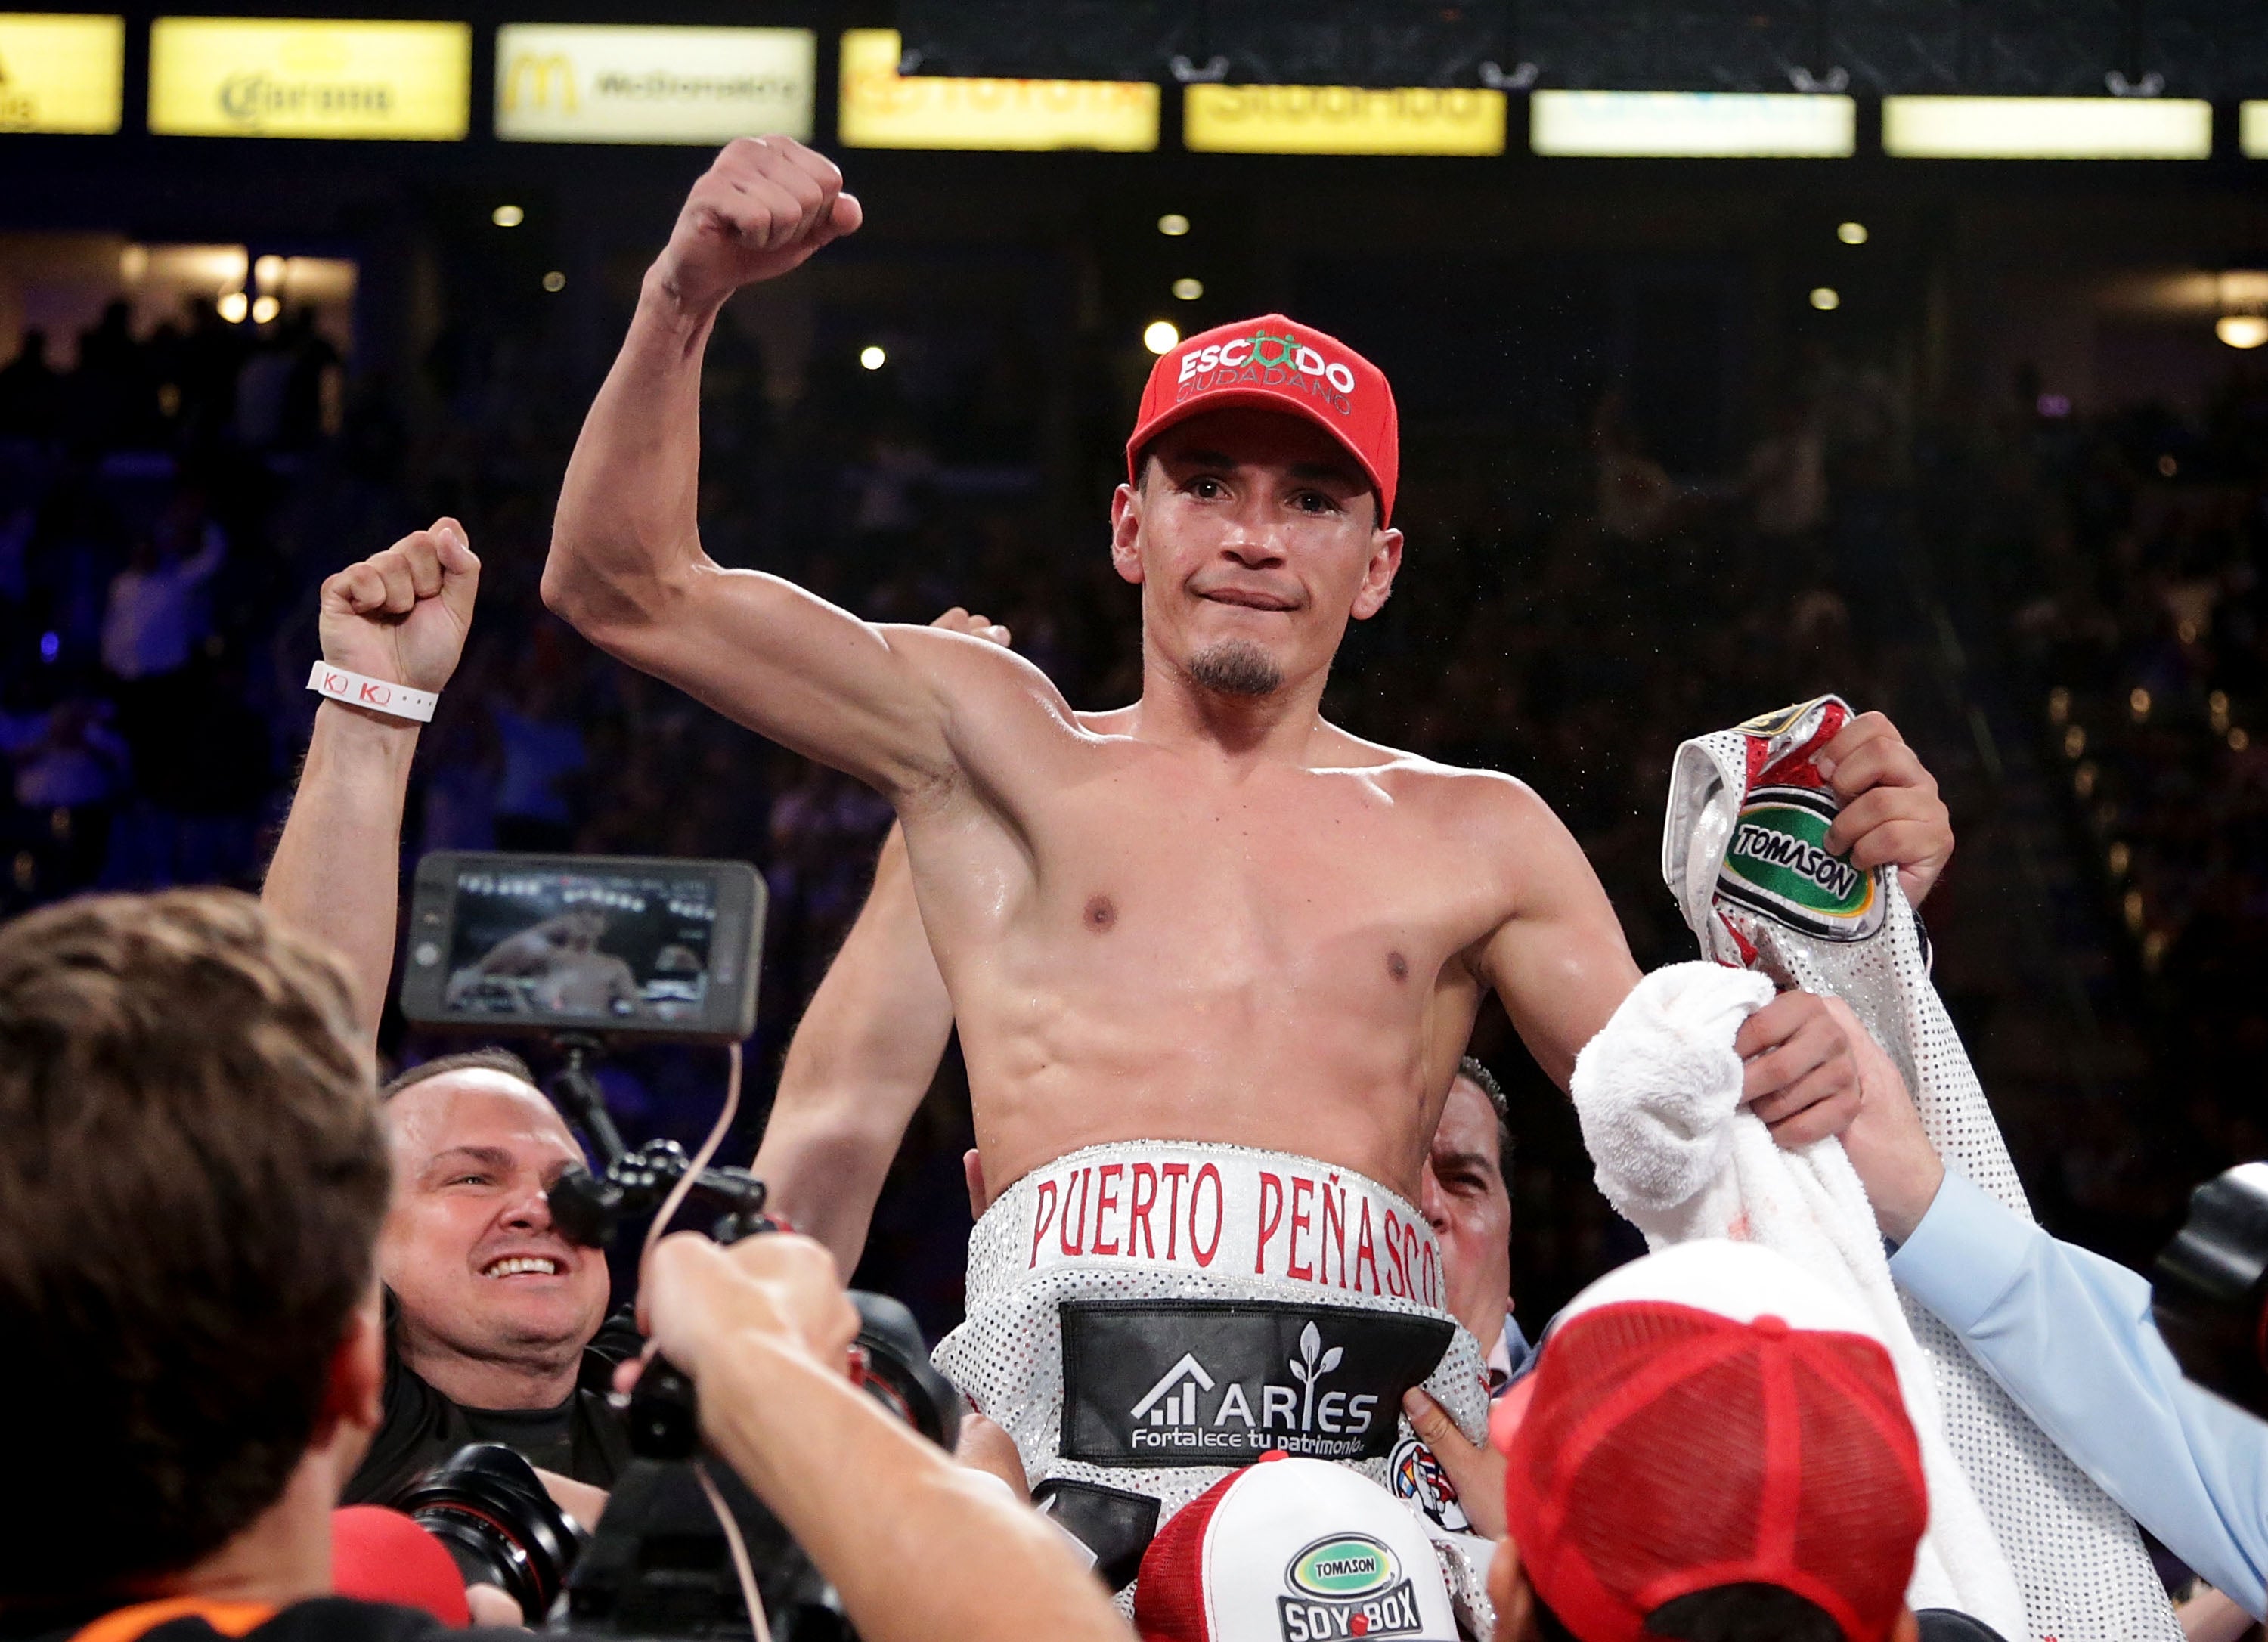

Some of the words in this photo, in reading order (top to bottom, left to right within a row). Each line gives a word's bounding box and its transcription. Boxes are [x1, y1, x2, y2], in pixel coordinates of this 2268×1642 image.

[1176, 367, 1352, 416] CIUDADANO
[1735, 826, 1857, 898] TOMASON
[1029, 1163, 1223, 1269] PUERTO
[1255, 1172, 1438, 1309] PEÑASCO
[1213, 1383, 1378, 1433] ARIES
[1131, 1427, 1242, 1448] Fortalece
[1249, 1428, 1271, 1448] tu
[1277, 1433, 1362, 1456] patrimonio
[1315, 1557, 1375, 1578] TOMASON
[1284, 1602, 1350, 1642] SOY
[1362, 1585, 1418, 1633] BOX
